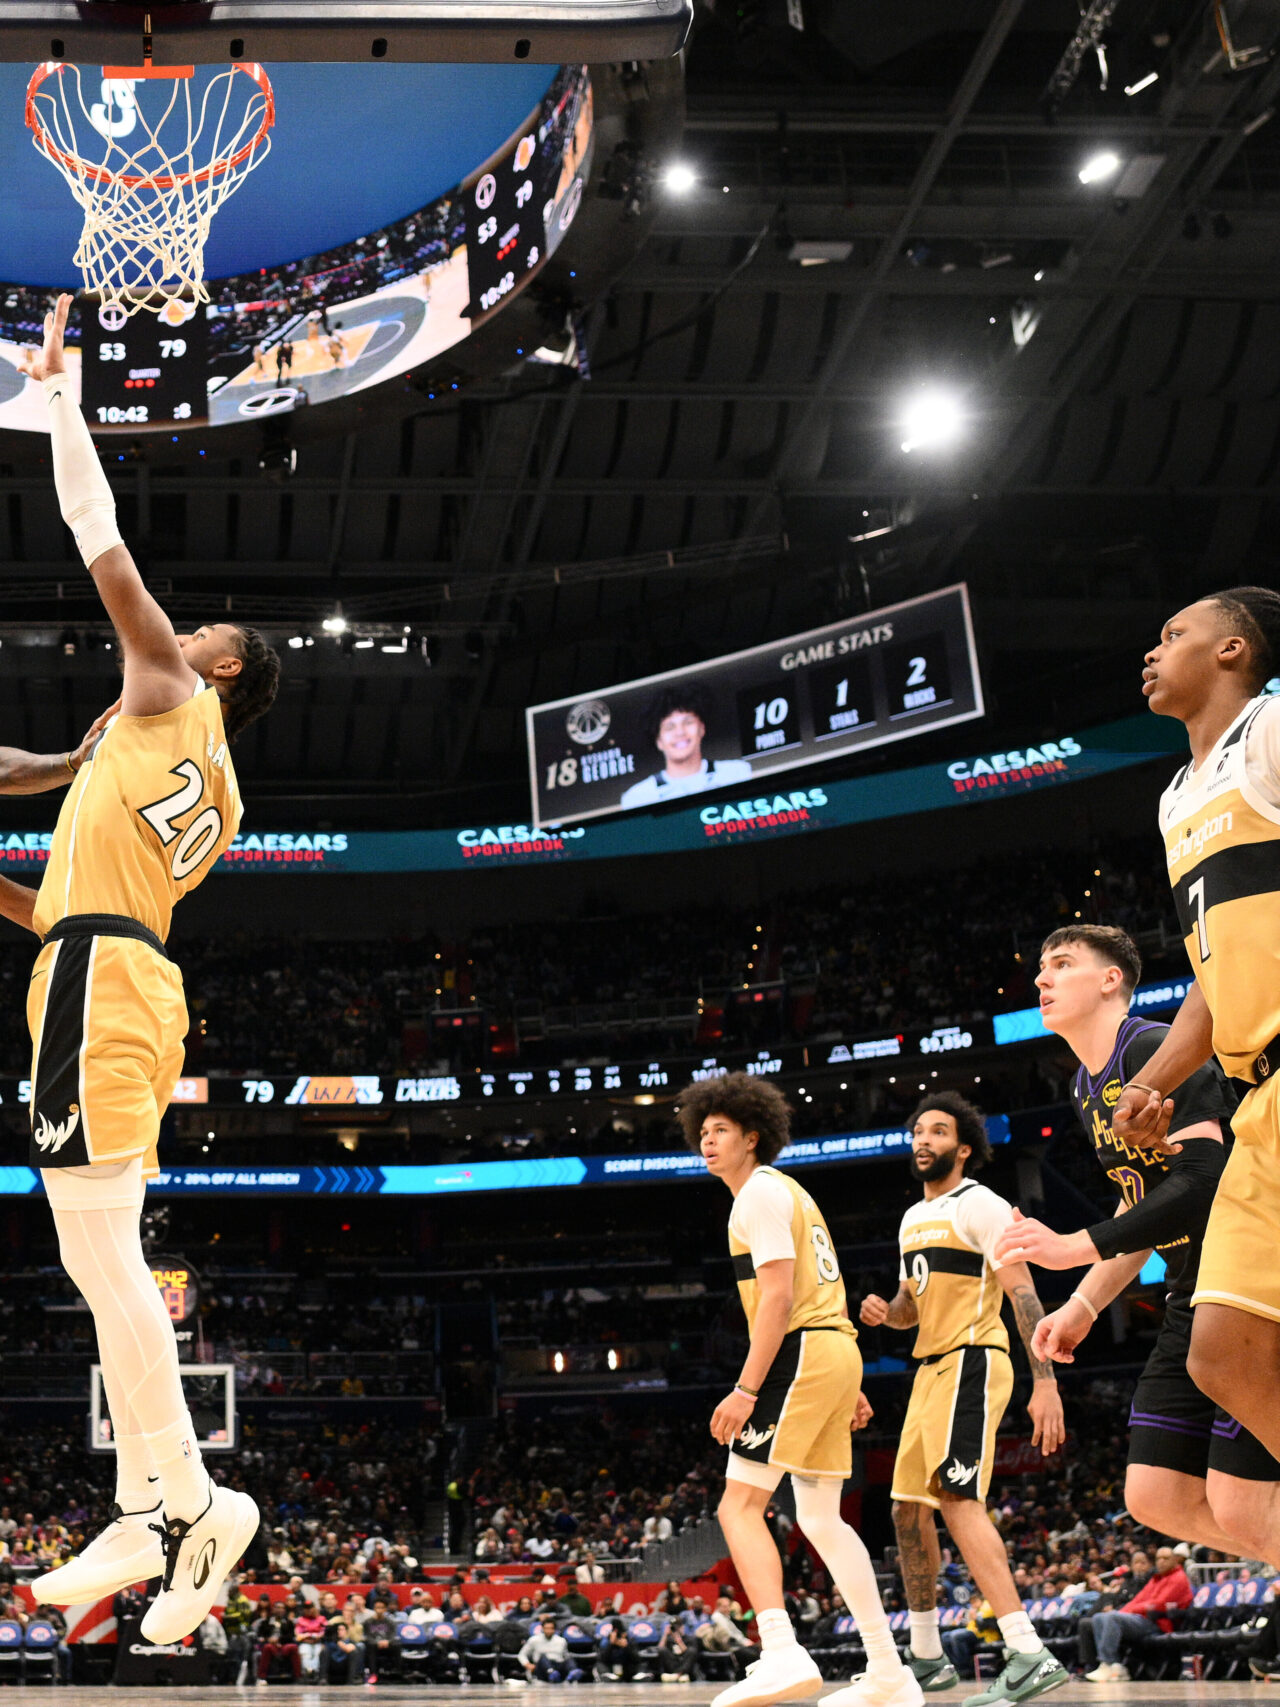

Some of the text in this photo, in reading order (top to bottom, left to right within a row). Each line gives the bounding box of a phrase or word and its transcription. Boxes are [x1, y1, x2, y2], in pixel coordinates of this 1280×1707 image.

[478, 216, 497, 244] 53
[480, 271, 515, 310] 10:42
[99, 339, 187, 361] 53 79
[97, 402, 192, 423] 10:42 :8
[780, 622, 893, 671] GAME STATS
[906, 657, 927, 687] 2
[836, 678, 848, 707] 1
[754, 697, 789, 730] 10
[582, 754, 635, 784] GEORGE
[946, 737, 1082, 780] CAESARS
[546, 758, 577, 790] 18
[953, 759, 1067, 792] SPORTSBOOK
[136, 758, 223, 881] 20
[700, 788, 828, 825] CAESARS
[704, 808, 809, 838] SPORTSBOOK
[462, 838, 564, 858] SPORTSBOOK
[1168, 811, 1233, 867] ashington
[223, 850, 324, 862] SPORTSBOOK
[1188, 876, 1211, 964] 7
[18, 1081, 31, 1102] 5
[242, 1081, 274, 1102] 79
[395, 1082, 460, 1102] LAKERS
[639, 1072, 668, 1088] 7/11
[782, 1146, 820, 1158] APITAL
[822, 1142, 845, 1154] ONE
[848, 1136, 882, 1151] DEBIT
[884, 1133, 902, 1147] OR
[184, 1172, 300, 1185] 20% OFF ALL MERCH
[604, 1158, 641, 1173] SCORE
[152, 1271, 188, 1288] 0:42
[912, 1253, 929, 1297] 9
